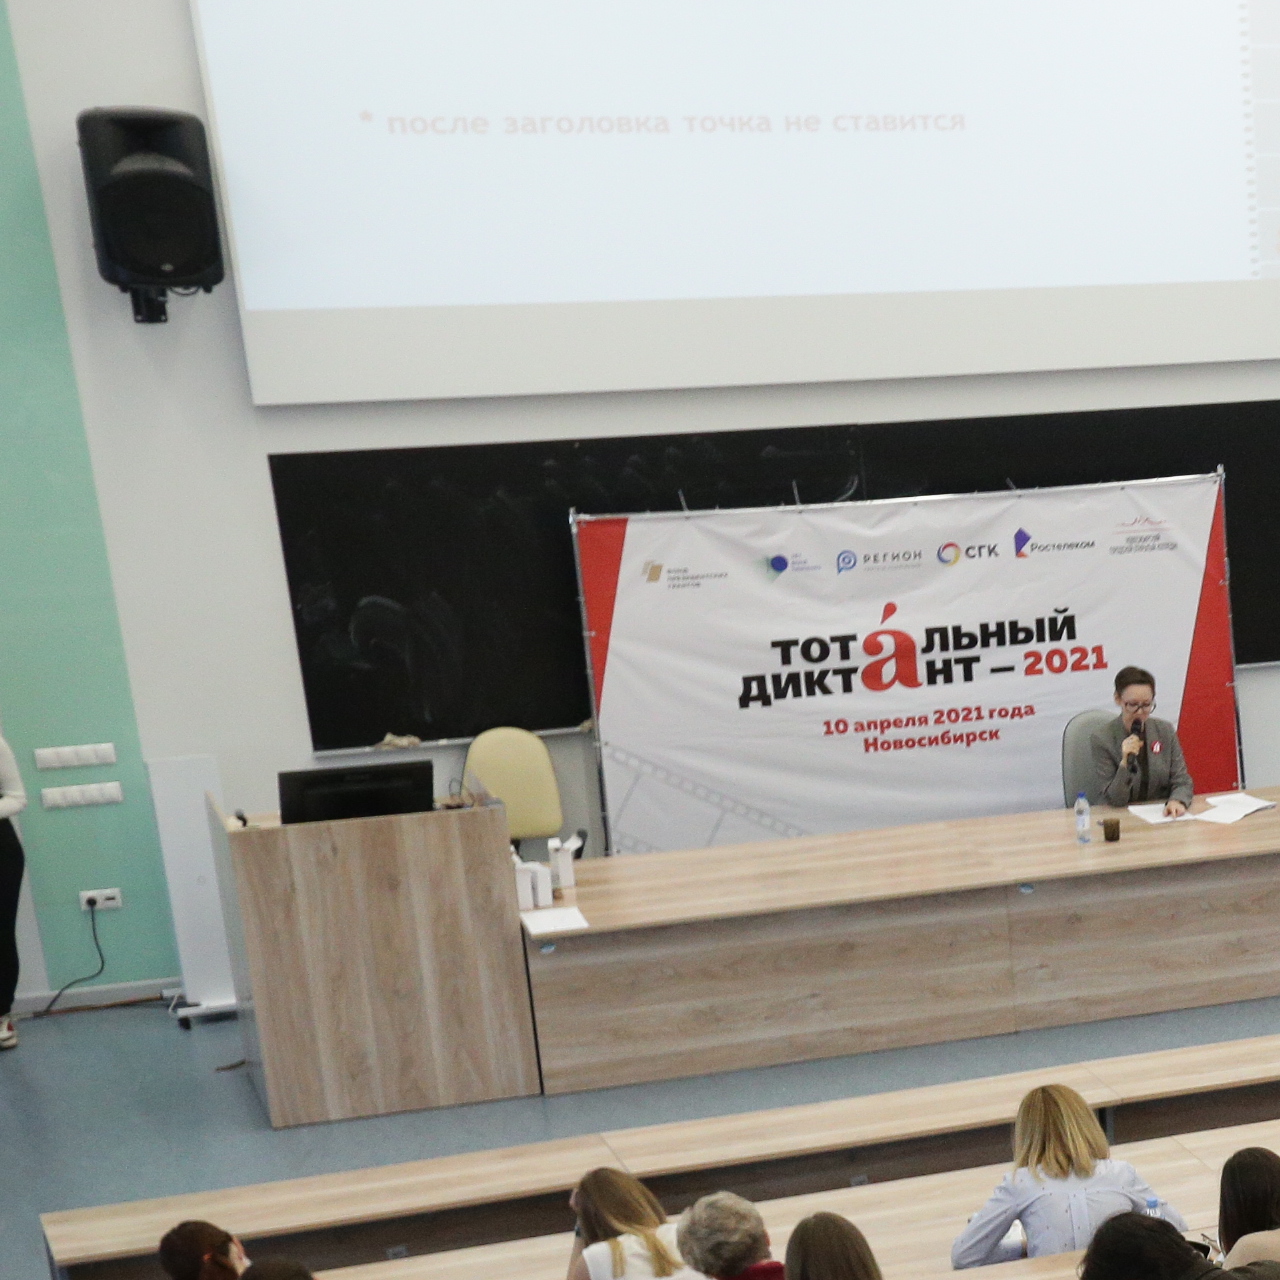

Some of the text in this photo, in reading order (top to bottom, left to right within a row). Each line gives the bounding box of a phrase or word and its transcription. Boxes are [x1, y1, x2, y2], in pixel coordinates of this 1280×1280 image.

[386, 111, 967, 134] после заголовка точка не ставится
[863, 550, 922, 564] РЕГИОН
[965, 543, 999, 559] СГК
[1023, 645, 1109, 677] 2021
[823, 701, 1036, 738] 10 апреля 2021 года
[863, 727, 1001, 753] Новосибирск
